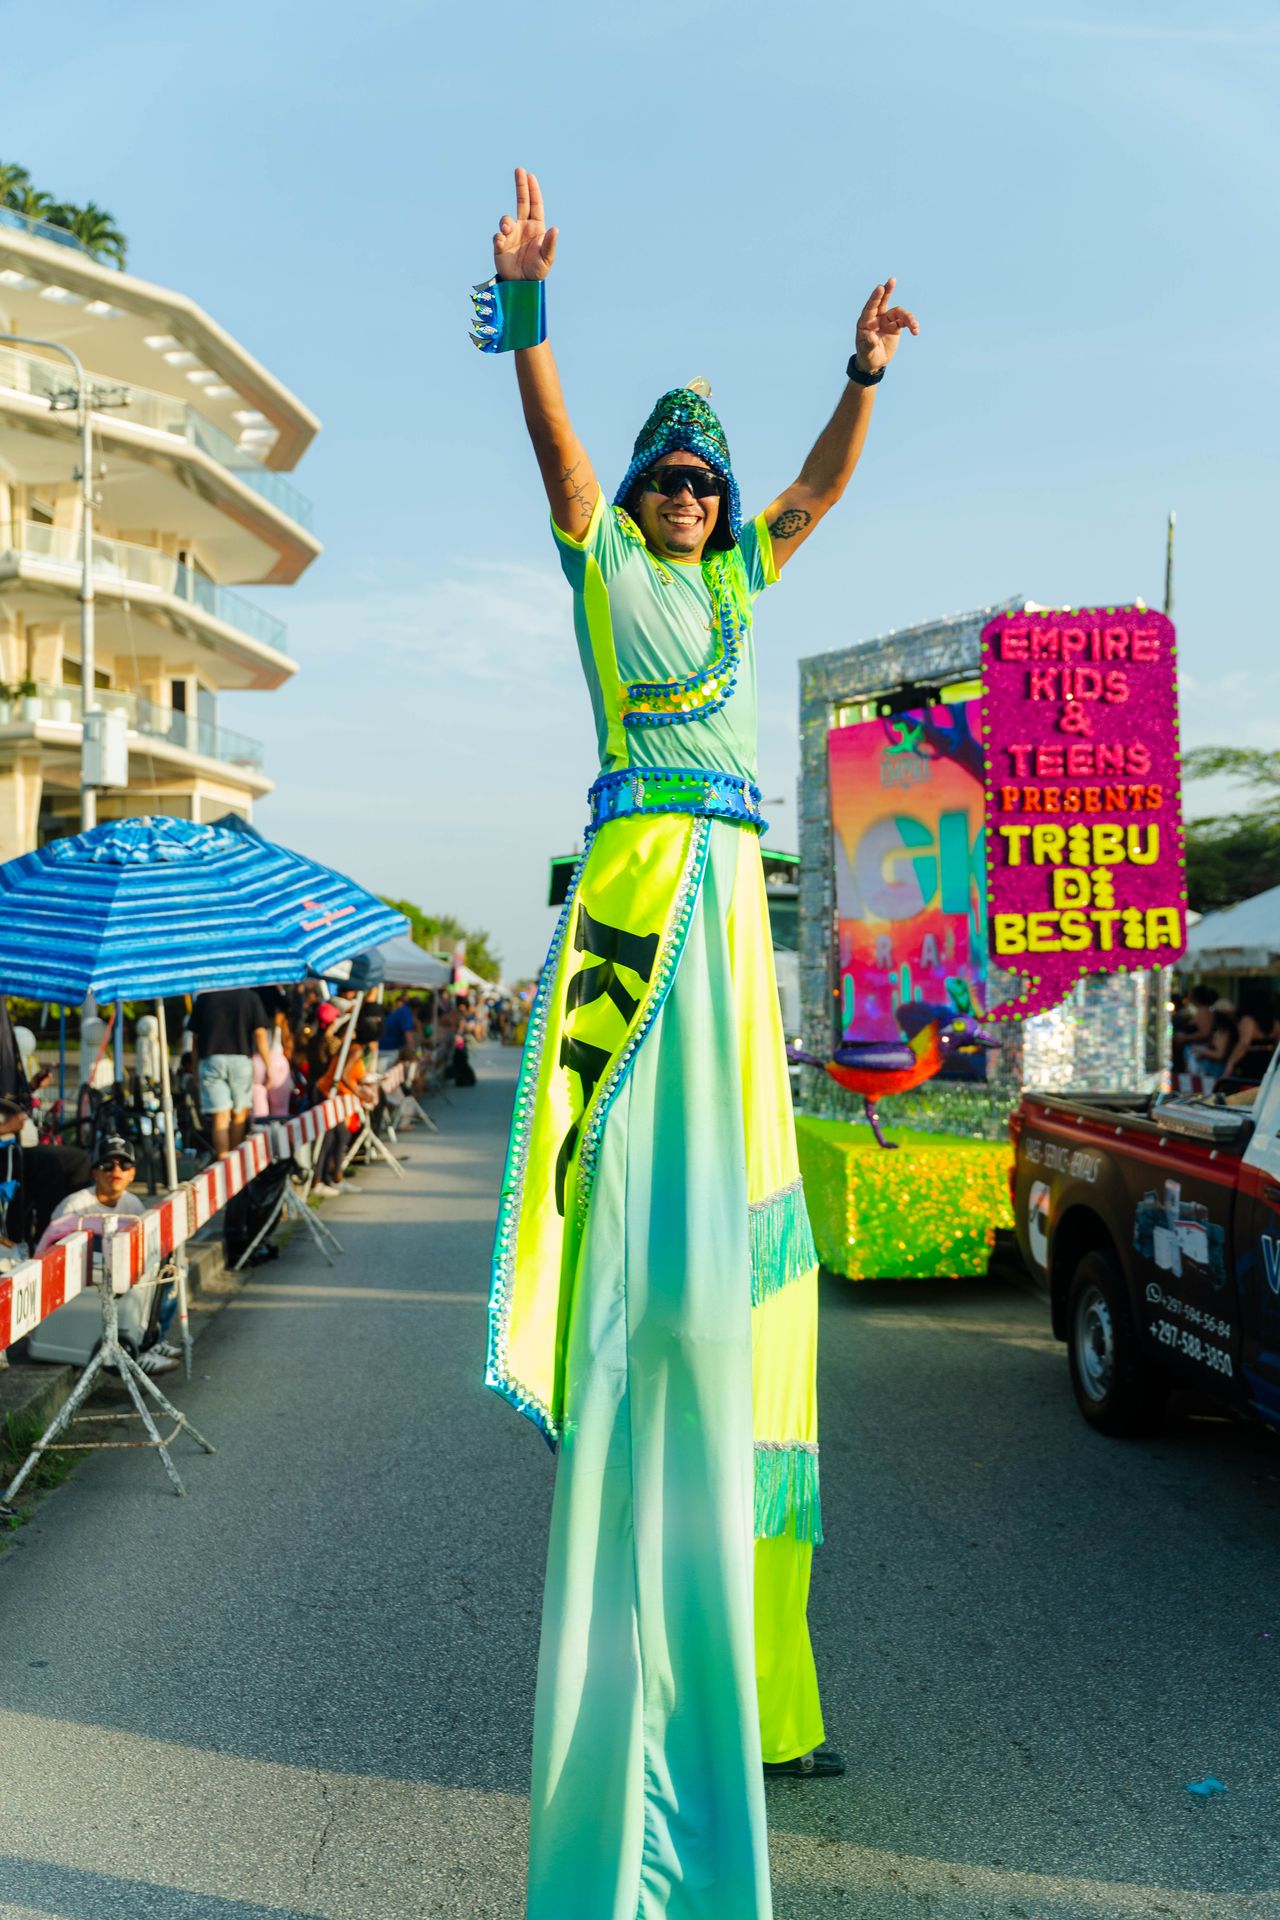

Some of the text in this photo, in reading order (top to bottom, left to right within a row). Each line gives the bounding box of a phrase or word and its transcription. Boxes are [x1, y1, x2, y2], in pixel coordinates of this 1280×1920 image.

[1000, 627, 1160, 662] EMPIRE
[1029, 667, 1130, 701] KIDS
[1060, 701, 1092, 736] &
[1007, 742, 1152, 777] TEENS
[1000, 785, 1163, 813] PRESENTS
[999, 823, 1161, 867] TRIBU
[994, 906, 1182, 955] BESTIA
